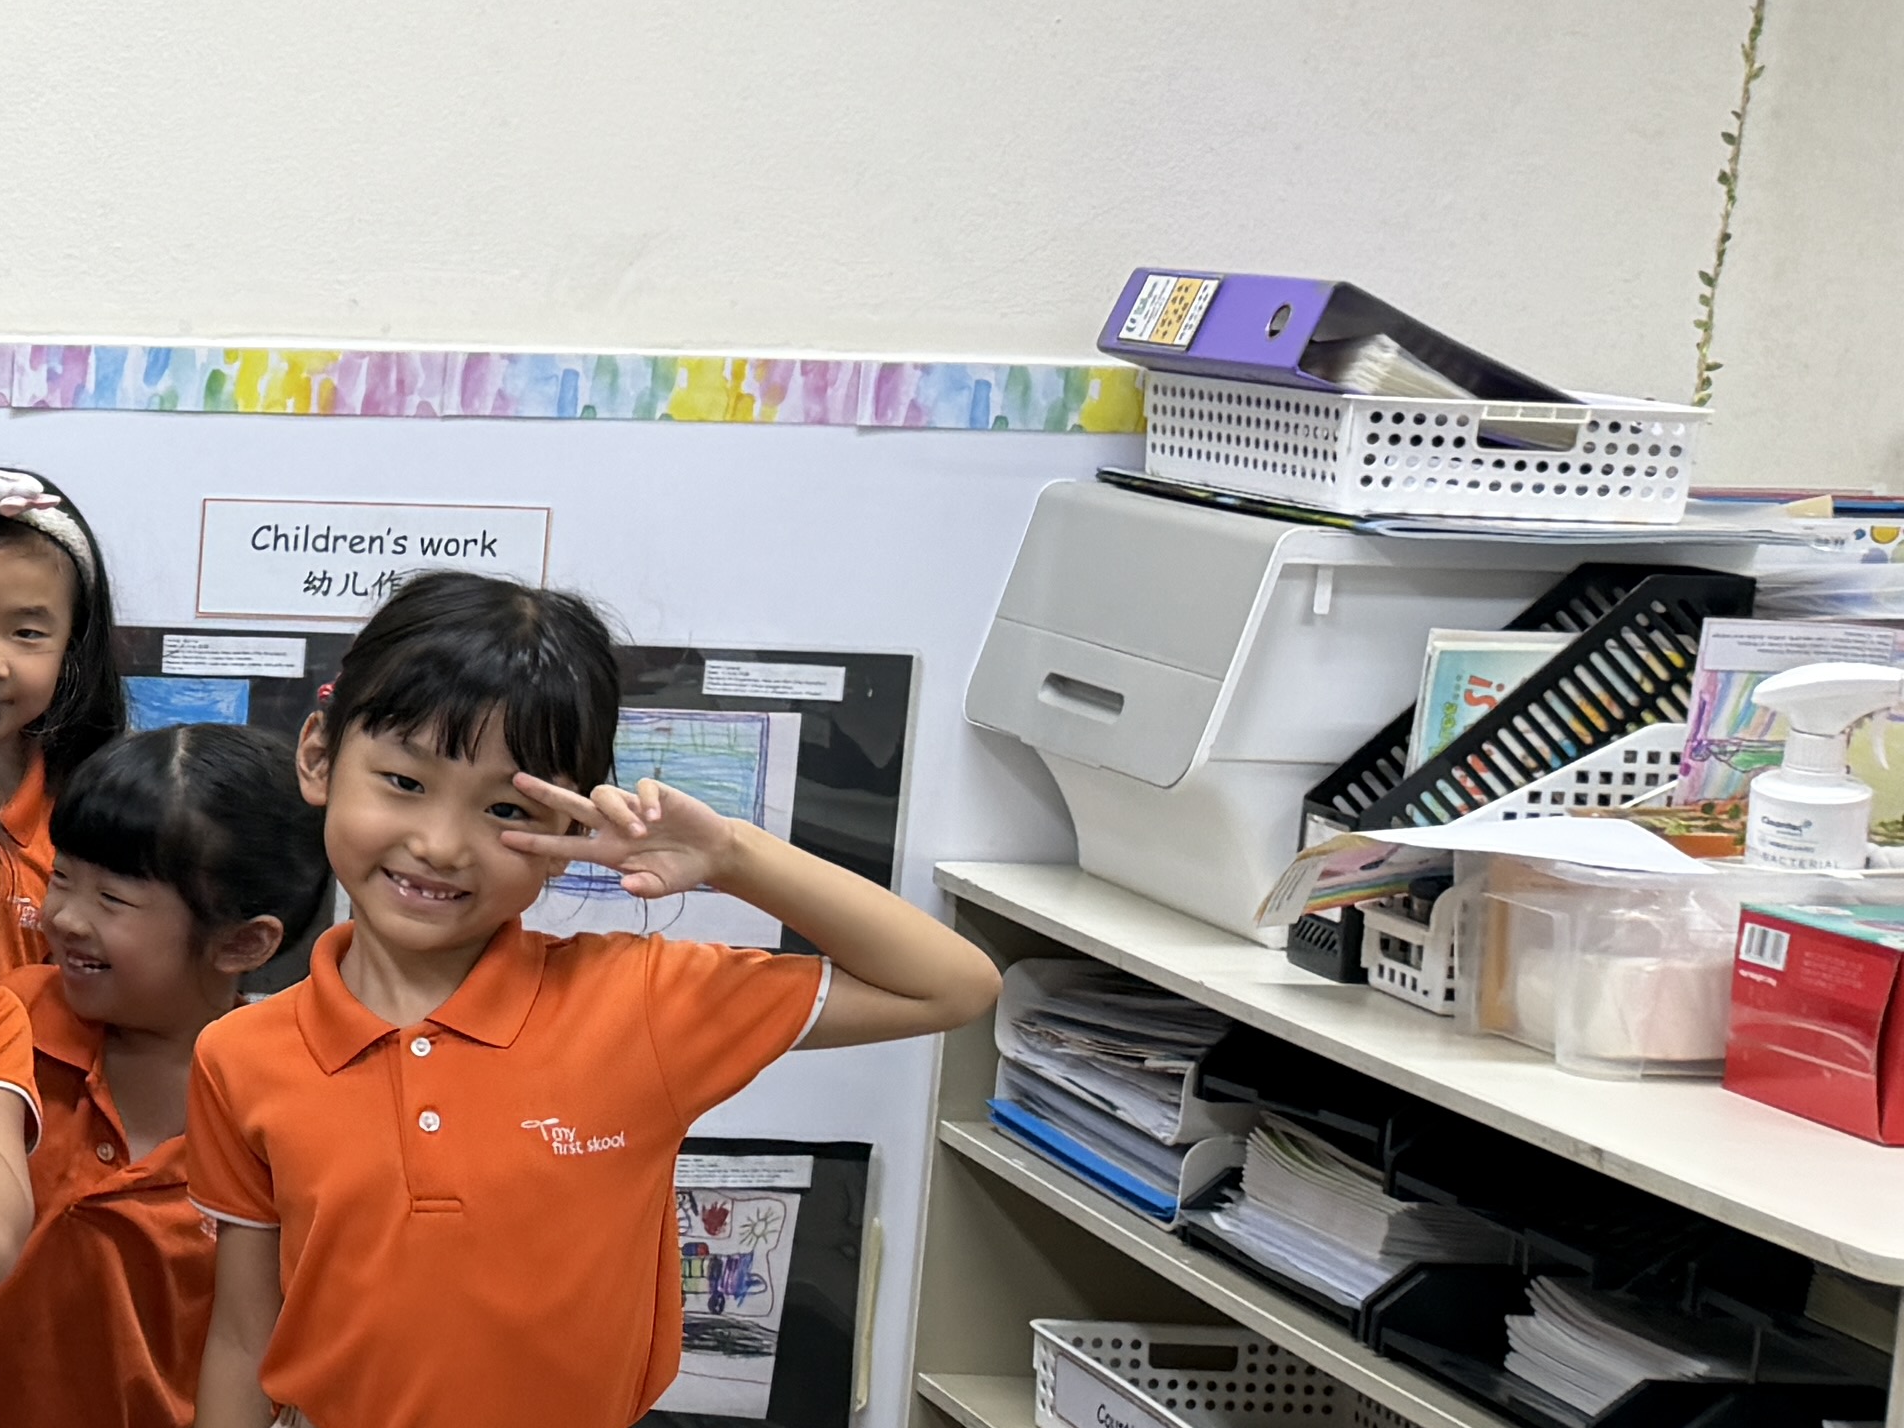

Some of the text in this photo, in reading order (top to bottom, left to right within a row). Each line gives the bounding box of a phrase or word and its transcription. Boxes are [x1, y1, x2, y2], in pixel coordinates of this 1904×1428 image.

[251, 524, 498, 557] Children's work
[551, 1127, 576, 1142] my
[552, 1130, 625, 1155] first skool
